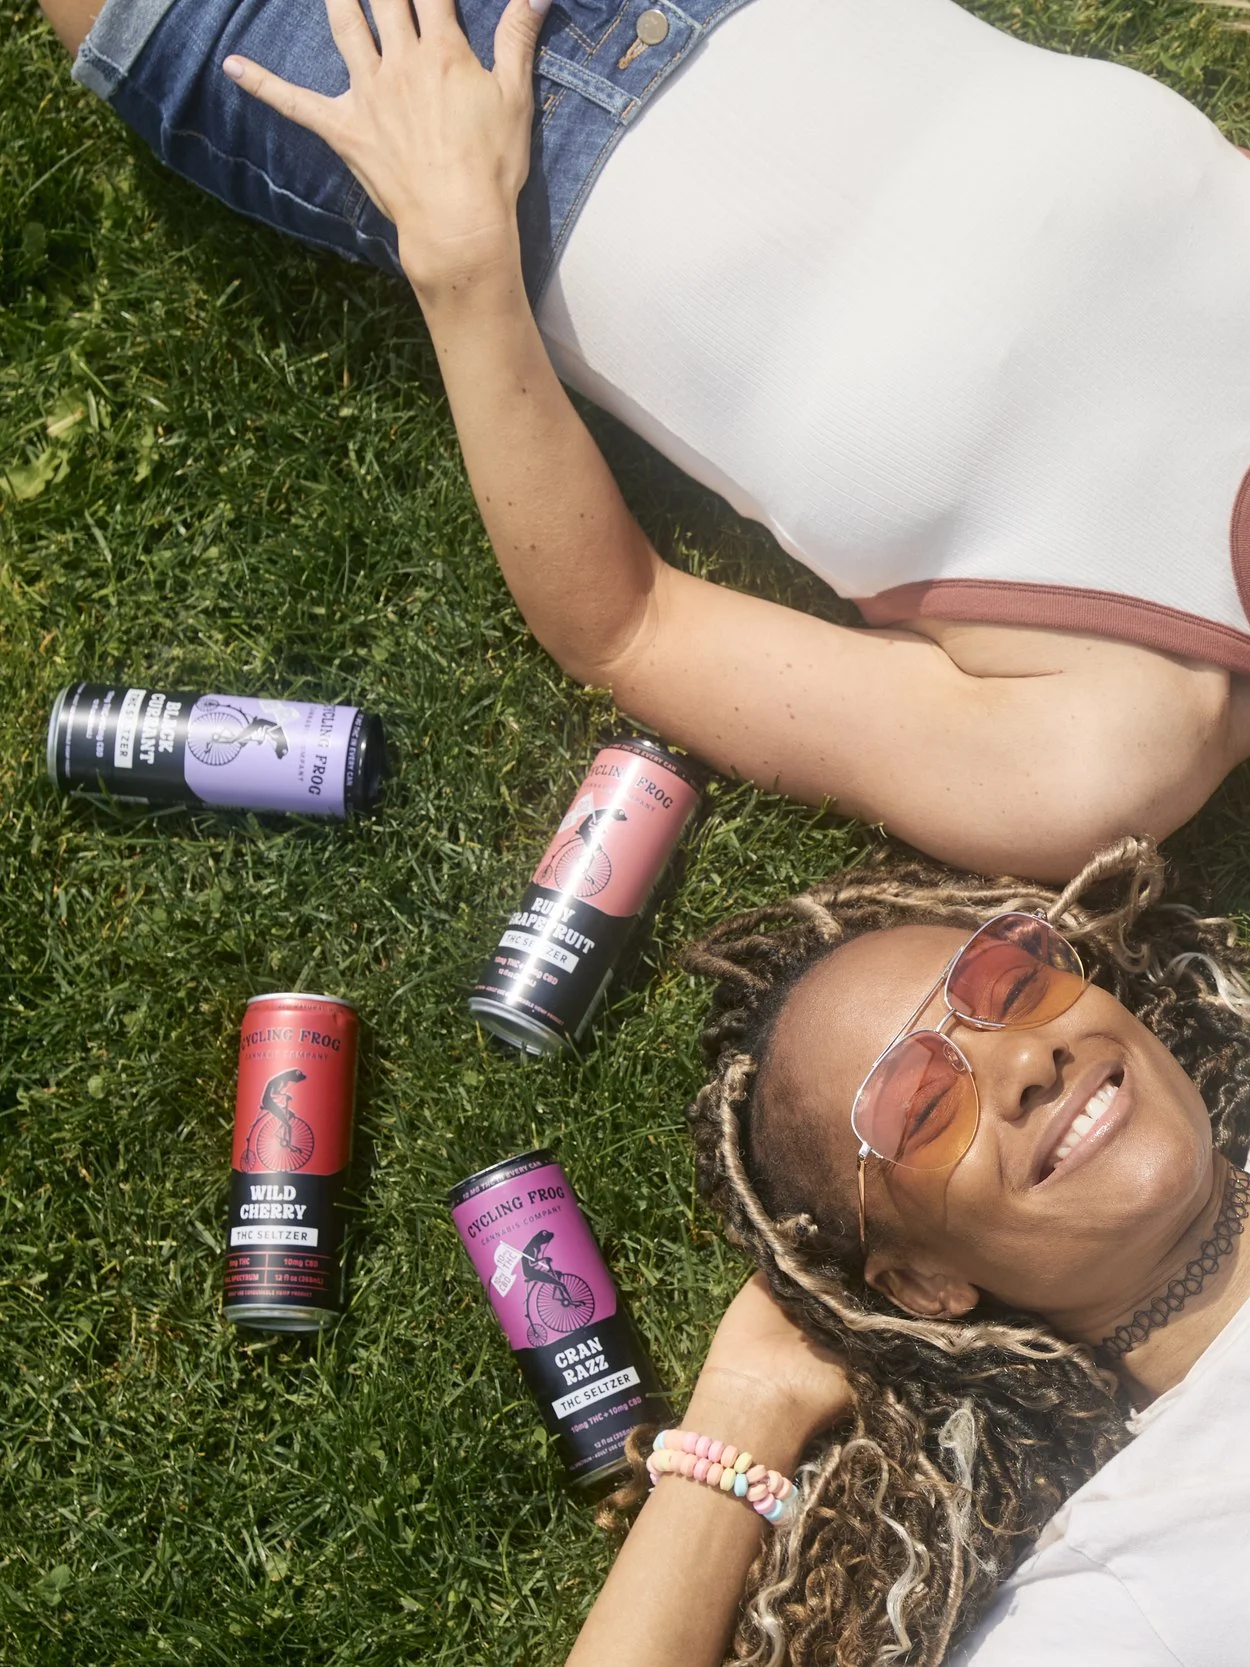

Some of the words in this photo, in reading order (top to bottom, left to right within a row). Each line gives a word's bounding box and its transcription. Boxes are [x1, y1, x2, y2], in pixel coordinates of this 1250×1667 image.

[140, 693, 167, 765] CURRANT
[158, 701, 182, 753] BLACK
[308, 754, 328, 796] FROG
[636, 776, 674, 810] FROG
[241, 1028, 293, 1050] CYCLING
[300, 1030, 341, 1052] FROG
[250, 1185, 296, 1201] WILD
[240, 1203, 307, 1220] CHERRY
[467, 1196, 524, 1239] CYCLING
[528, 1186, 565, 1205] FROG
[481, 1222, 521, 1246] CANNABIS
[523, 1205, 562, 1225] COMPANY
[237, 1231, 253, 1240] THC
[257, 1230, 308, 1240] SELTZER
[555, 1336, 603, 1369] CRAN
[562, 1354, 609, 1386] RAZZ
[560, 1395, 582, 1411] THC
[584, 1373, 631, 1400] SELTZER
[571, 1421, 589, 1433] 10mg
[588, 1413, 604, 1425] THC
[608, 1403, 629, 1415] 10mg
[628, 1396, 642, 1407] CBD
